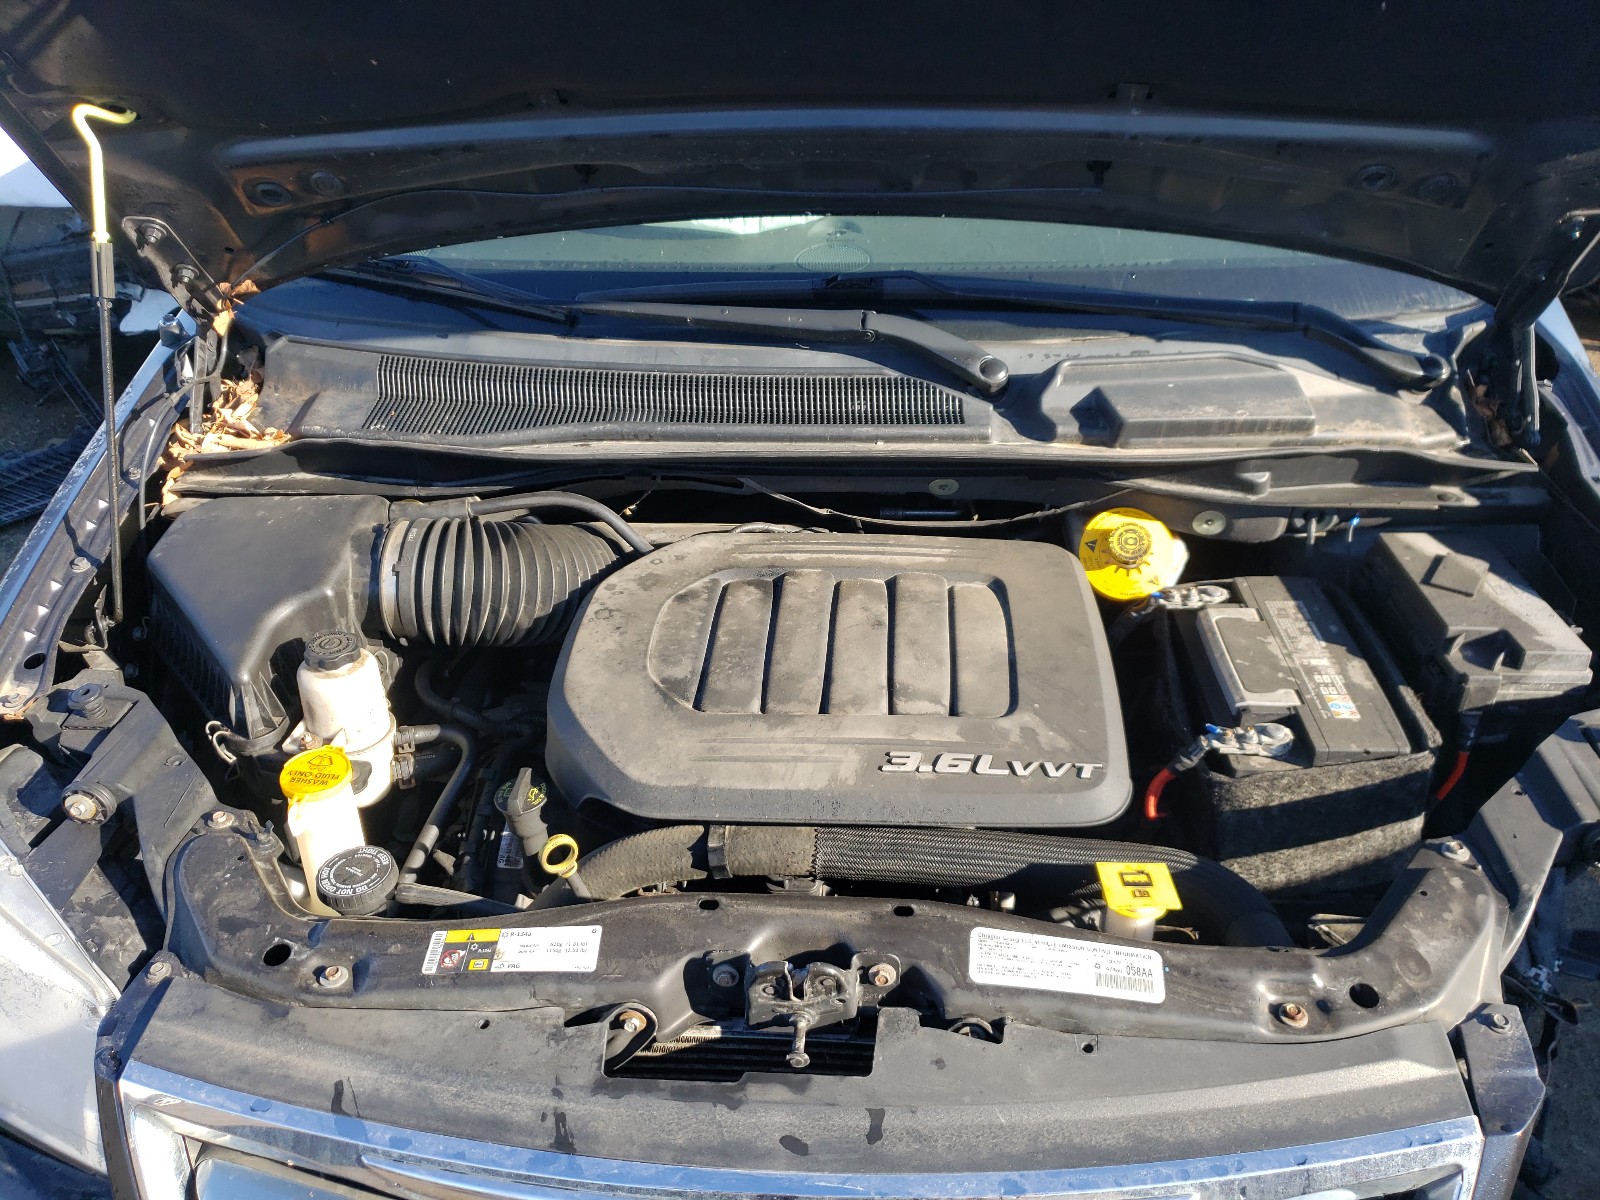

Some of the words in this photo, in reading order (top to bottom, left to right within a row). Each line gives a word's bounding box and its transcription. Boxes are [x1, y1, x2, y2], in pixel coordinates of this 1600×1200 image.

[878, 751, 1010, 777] 3.6L
[1007, 760, 1104, 780] VVT
[287, 769, 313, 779] ONLY
[315, 771, 341, 781] FLUID
[289, 777, 329, 787] WASHER
[357, 847, 379, 856] TIGHT
[377, 852, 390, 866] KEEP
[320, 866, 331, 880] HOT
[321, 879, 337, 892] OPEN
[356, 885, 369, 893] DO
